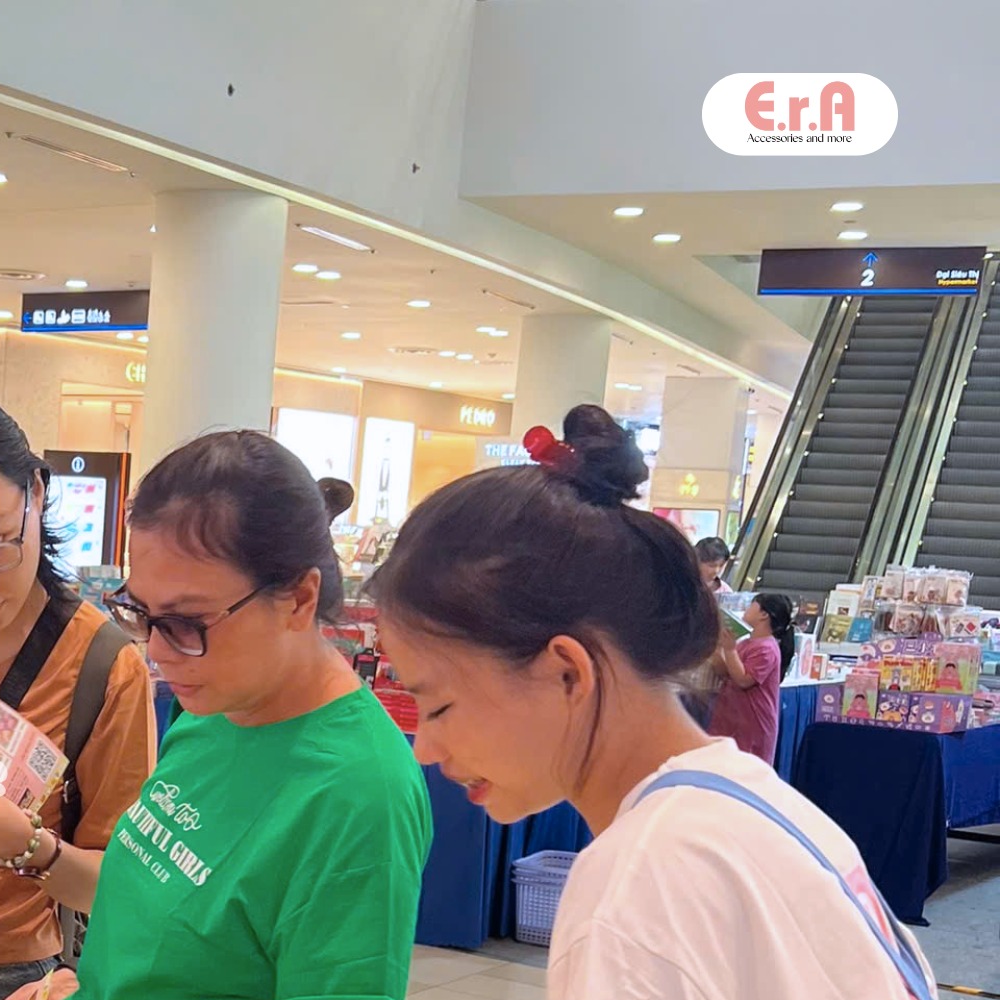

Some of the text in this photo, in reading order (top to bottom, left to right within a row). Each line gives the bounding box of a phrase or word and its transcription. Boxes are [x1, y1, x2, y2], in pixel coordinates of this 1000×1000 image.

[860, 268, 875, 287] 2
[460, 405, 496, 427] PEDRO
[485, 443, 507, 457] THE
[169, 840, 213, 886] GIRLS
